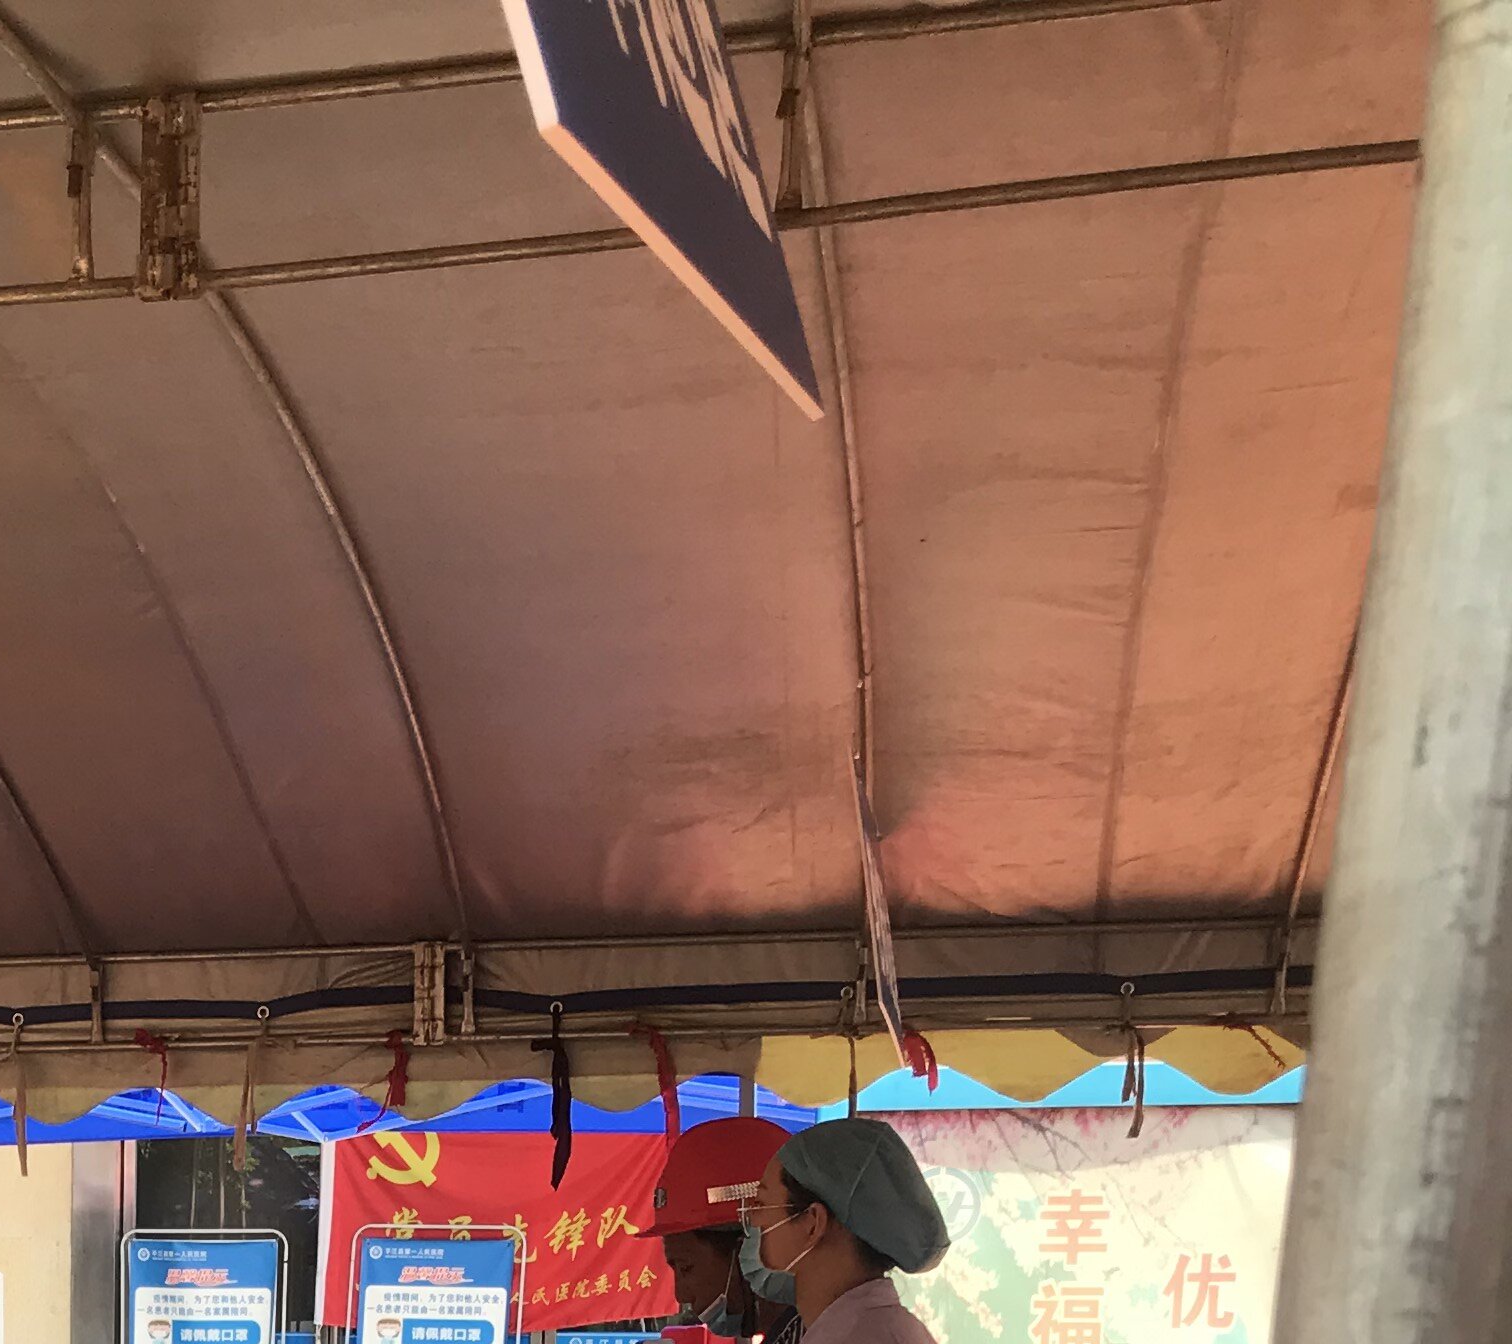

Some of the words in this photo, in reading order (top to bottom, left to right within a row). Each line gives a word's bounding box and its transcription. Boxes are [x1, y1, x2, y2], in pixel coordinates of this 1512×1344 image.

[180, 1328, 248, 1342] 请佩戴口罩
[411, 1326, 482, 1342] 请佩戴口罩
